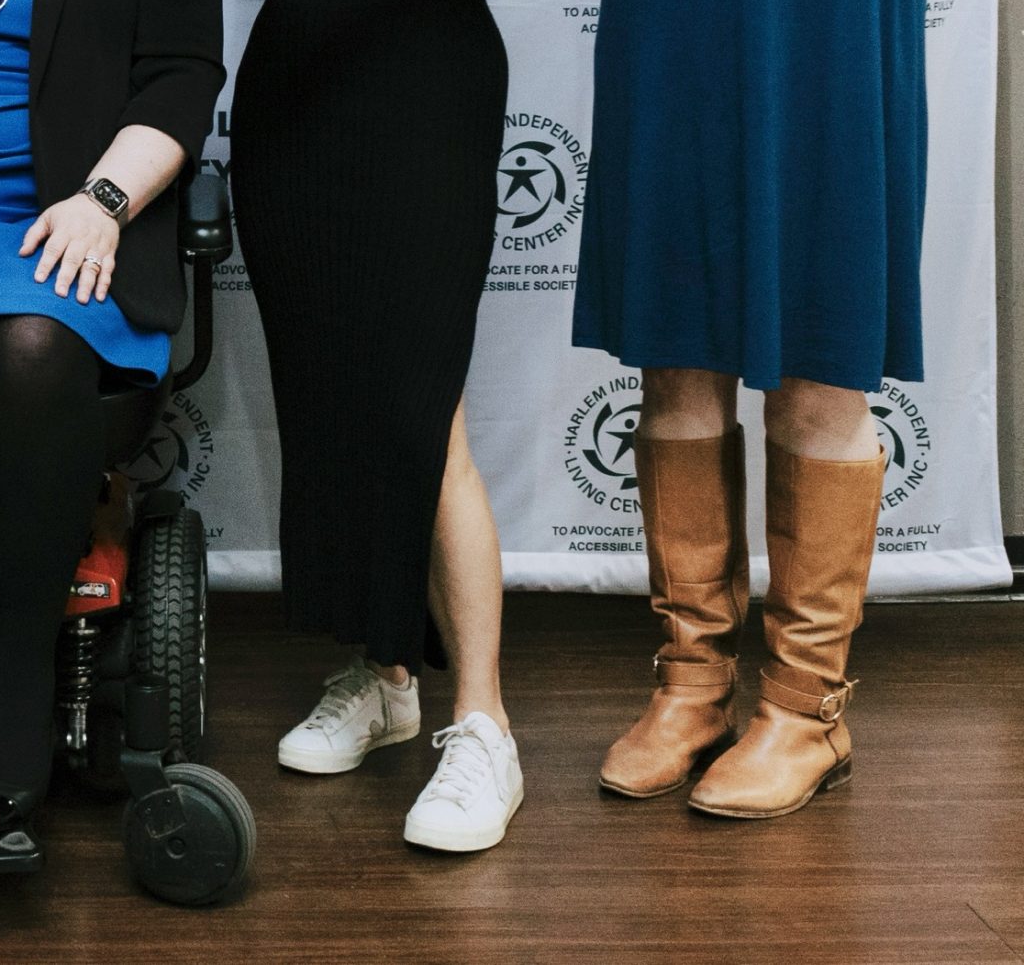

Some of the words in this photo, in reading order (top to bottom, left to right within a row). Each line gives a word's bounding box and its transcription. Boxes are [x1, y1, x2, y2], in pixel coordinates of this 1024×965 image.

[502, 222, 568, 251] CENTER
[525, 264, 549, 274] FOR
[551, 264, 560, 274] A
[564, 386, 607, 446] HARLEM
[565, 457, 606, 505] LIVING
[552, 525, 568, 536] TO
[570, 525, 635, 537] ADVOCATE
[896, 526, 906, 537] A
[906, 523, 942, 536] FULLY
[568, 541, 643, 552] ACCESSIBLE
[877, 540, 928, 552] SOCIETY
